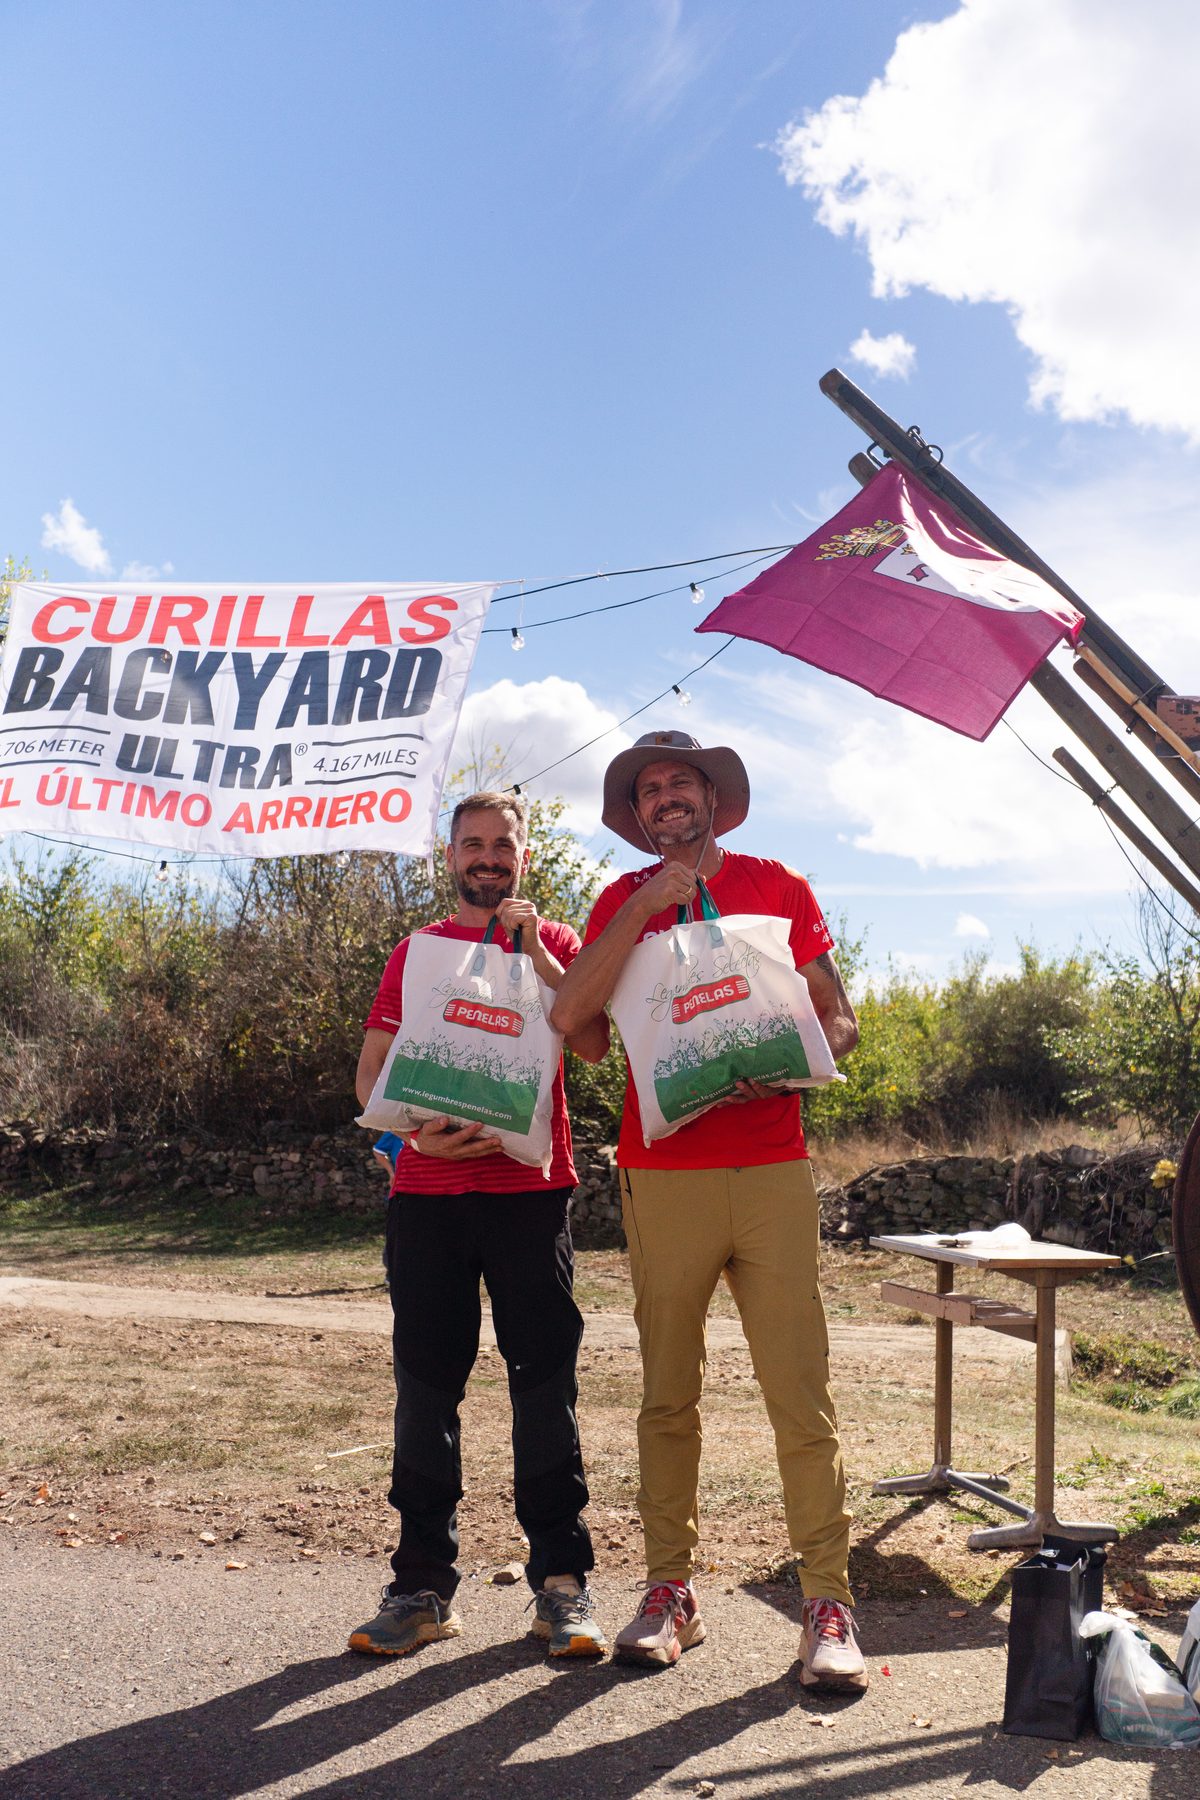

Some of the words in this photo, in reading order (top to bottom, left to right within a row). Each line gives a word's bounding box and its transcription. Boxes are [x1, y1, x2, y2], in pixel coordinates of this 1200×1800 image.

[31, 595, 459, 647] CURILLAS
[2, 646, 443, 731] BACKYARD
[0, 740, 38, 757] .706
[38, 739, 105, 757] METER
[313, 754, 363, 773] 4.167
[363, 749, 419, 768] MILES
[0, 777, 21, 808] L
[36, 767, 211, 828] ÚLTIMO
[221, 787, 412, 835] ARRIERO
[683, 984, 735, 1014] PENELAS
[456, 1006, 510, 1028] PENELAS
[402, 1086, 513, 1121] www.legumbrespenelas.com
